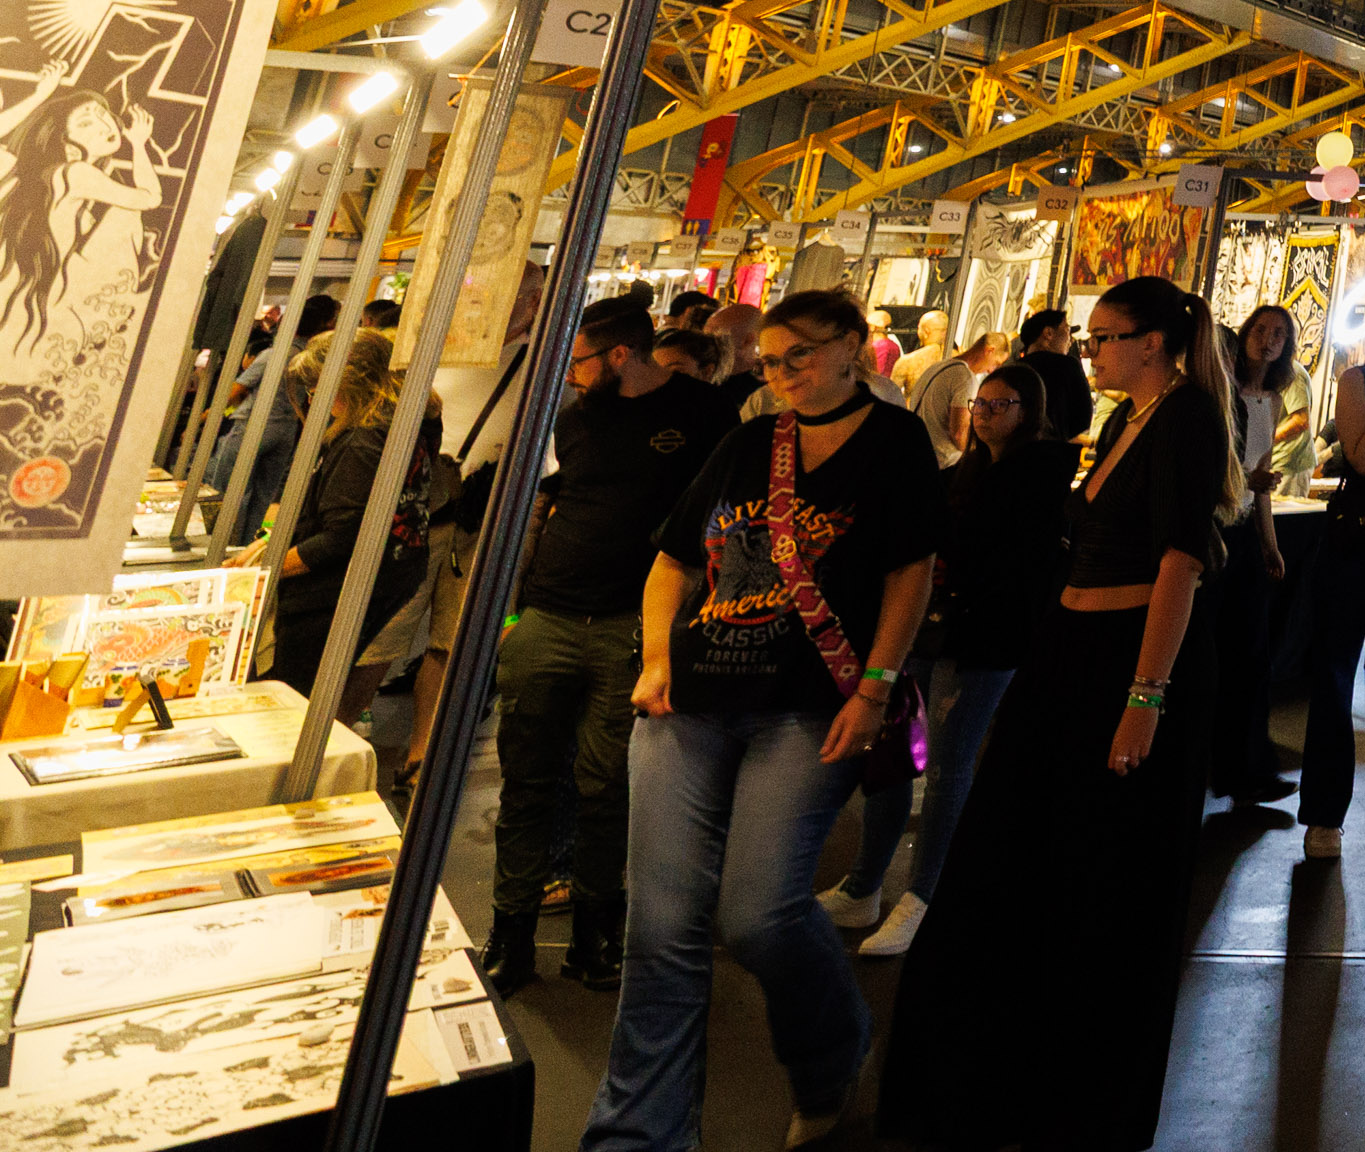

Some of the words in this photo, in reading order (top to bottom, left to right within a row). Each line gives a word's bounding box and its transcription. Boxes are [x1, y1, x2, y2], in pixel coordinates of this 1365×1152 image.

[565, 10, 613, 36] C2
[1184, 179, 1209, 193] C31
[1045, 199, 1068, 210] C32
[939, 211, 961, 222] C33
[841, 220, 861, 230] C34
[774, 229, 793, 240] C35
[717, 499, 770, 530] LIV
[702, 617, 790, 647] CLASSIC
[705, 649, 769, 662] FOREVER
